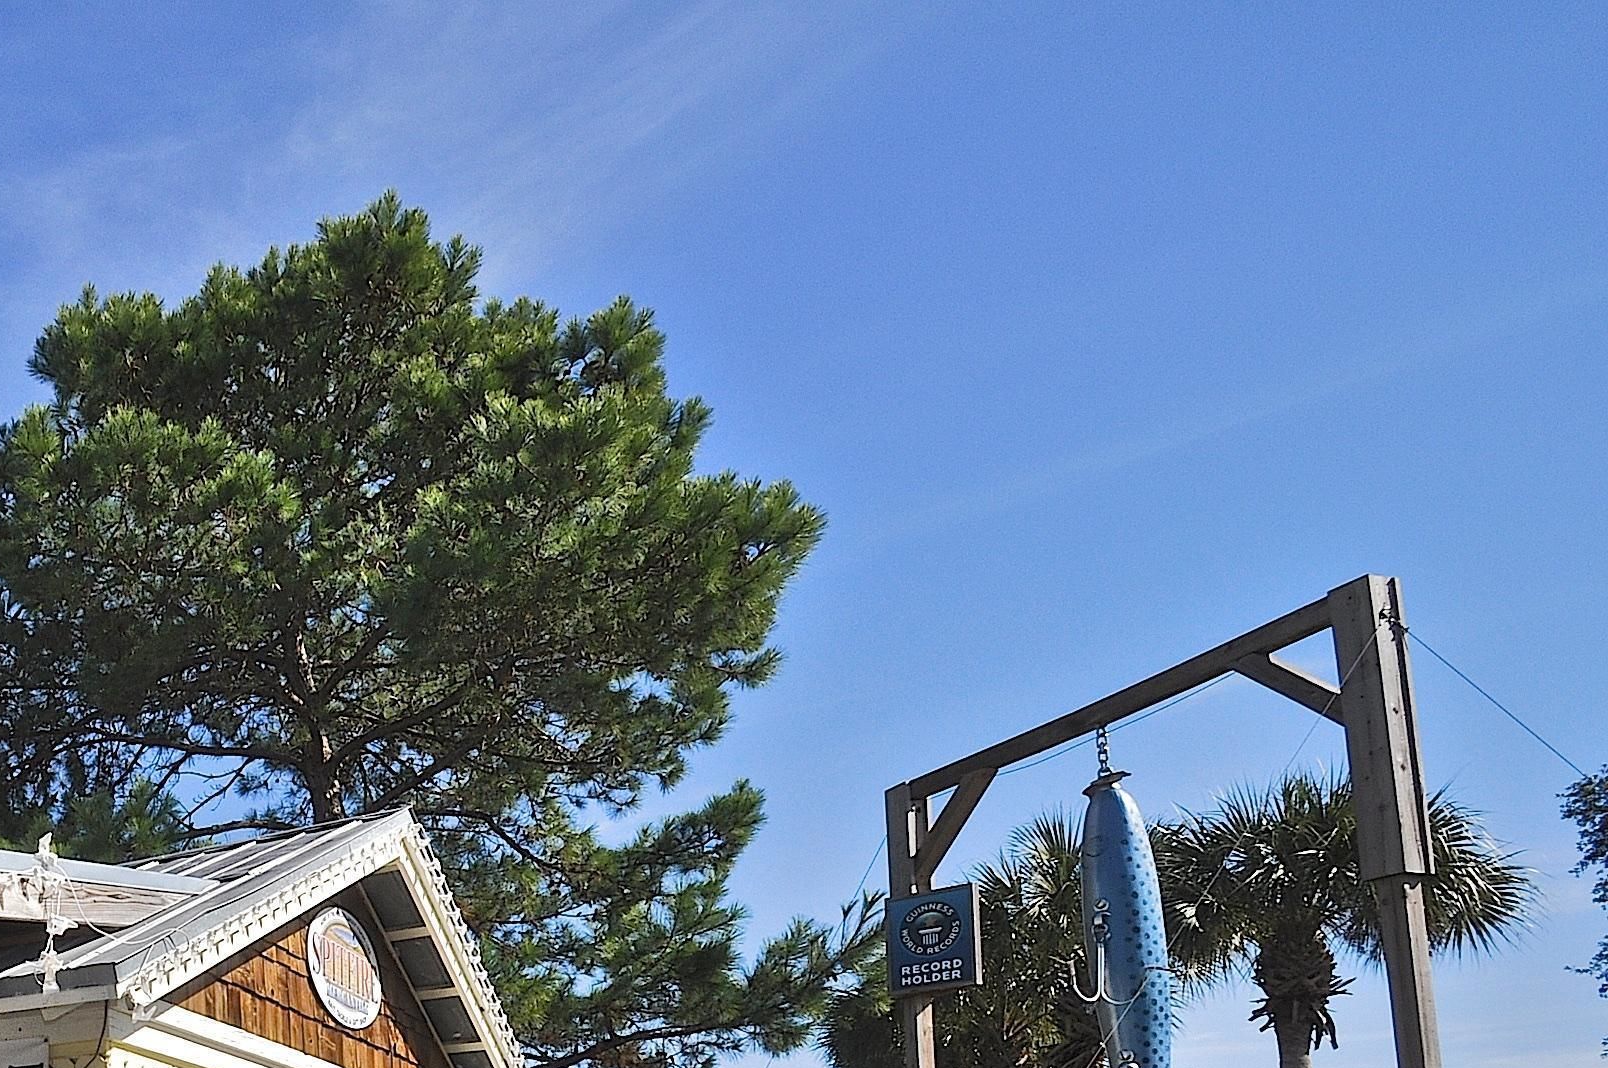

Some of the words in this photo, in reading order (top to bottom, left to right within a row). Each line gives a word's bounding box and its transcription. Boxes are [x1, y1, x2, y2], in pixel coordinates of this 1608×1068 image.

[906, 903, 954, 922] GUINNESS
[900, 928, 924, 954] WORLD
[926, 920, 961, 955] RECORDS
[901, 959, 962, 976] RECORD
[901, 969, 962, 986] HOLDER
